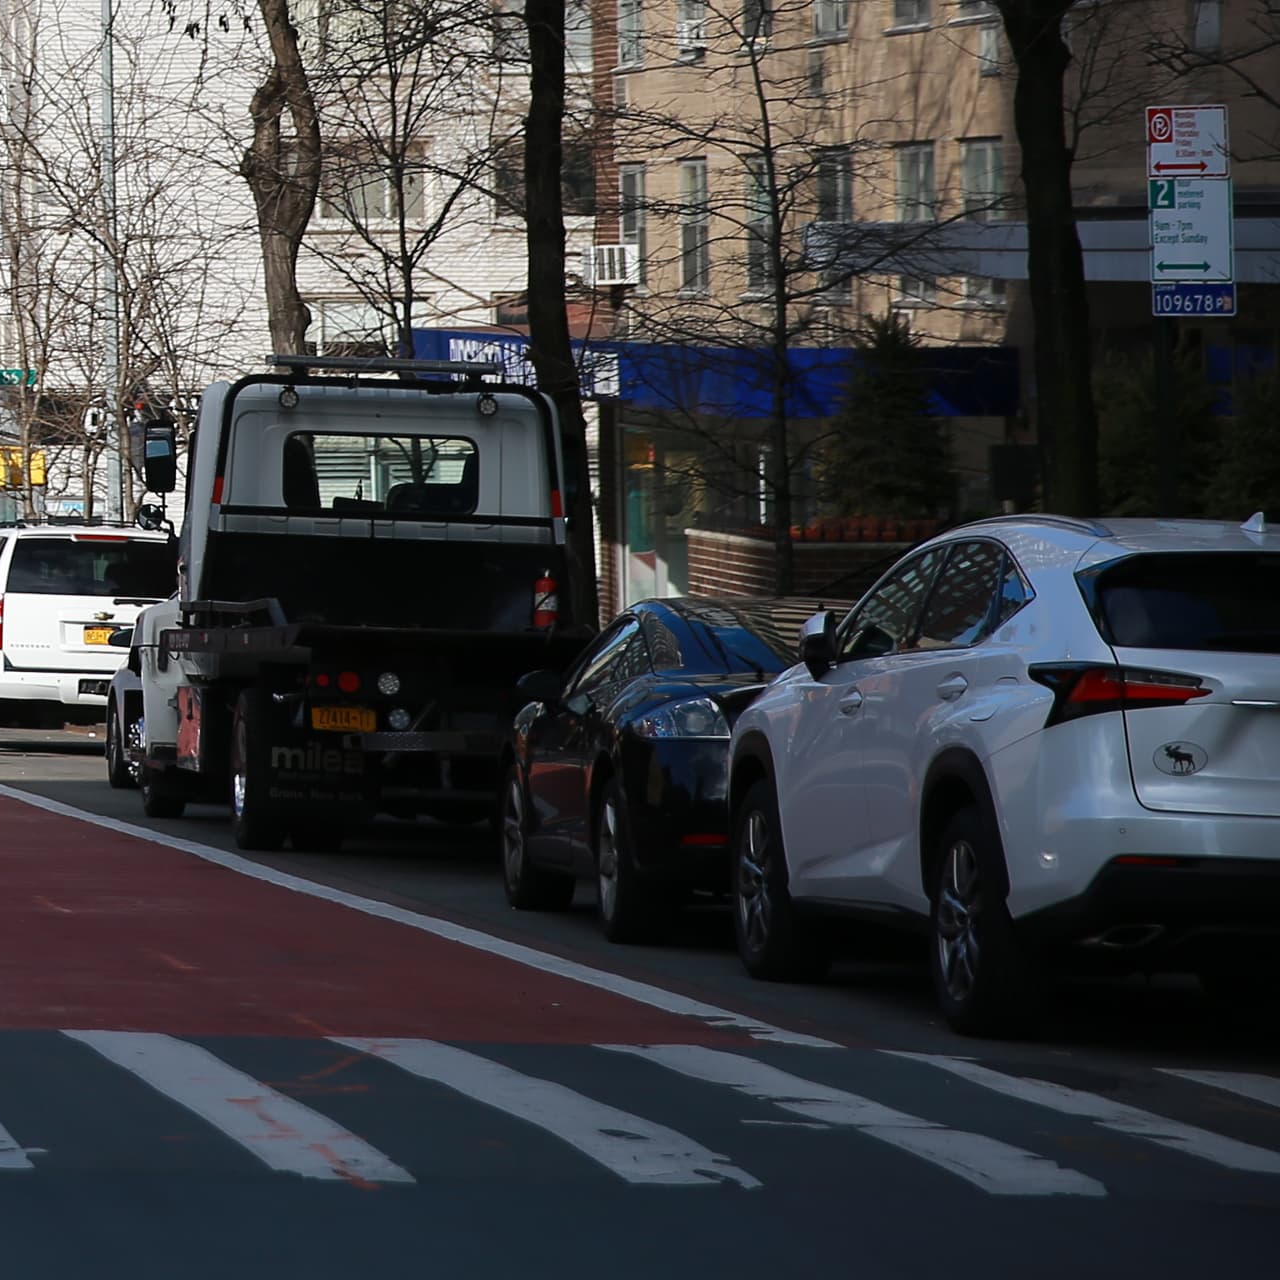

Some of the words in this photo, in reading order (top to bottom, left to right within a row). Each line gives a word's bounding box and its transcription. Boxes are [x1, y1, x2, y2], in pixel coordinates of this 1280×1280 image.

[1156, 181, 1170, 206] 2
[1155, 234, 1179, 245] Except
[1181, 233, 1208, 245] Sunday
[1156, 294, 1214, 312] 109678
[271, 739, 366, 776] milea
